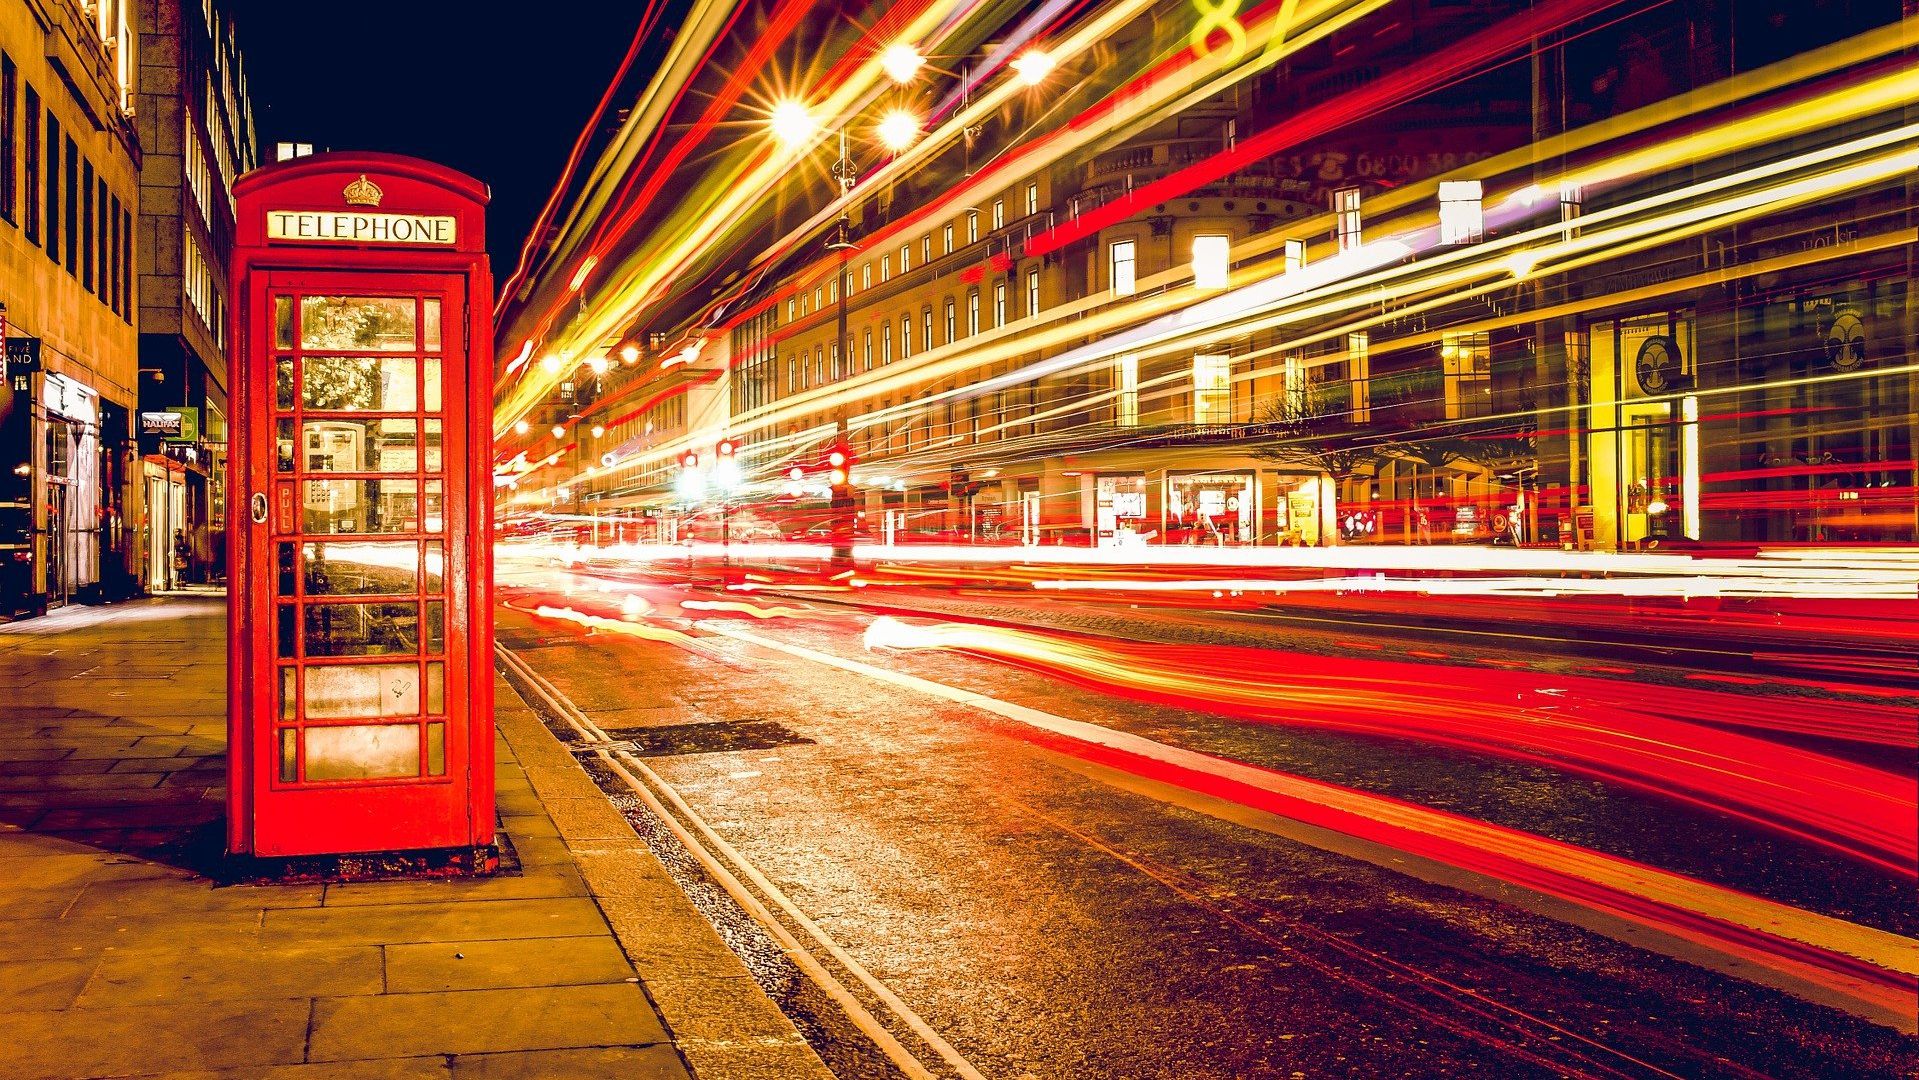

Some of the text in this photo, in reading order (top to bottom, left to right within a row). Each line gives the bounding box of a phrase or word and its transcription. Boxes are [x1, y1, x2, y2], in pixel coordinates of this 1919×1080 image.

[274, 214, 449, 241] TELEPHONE
[142, 419, 180, 428] HALIFAX
[282, 488, 290, 529] PULL
